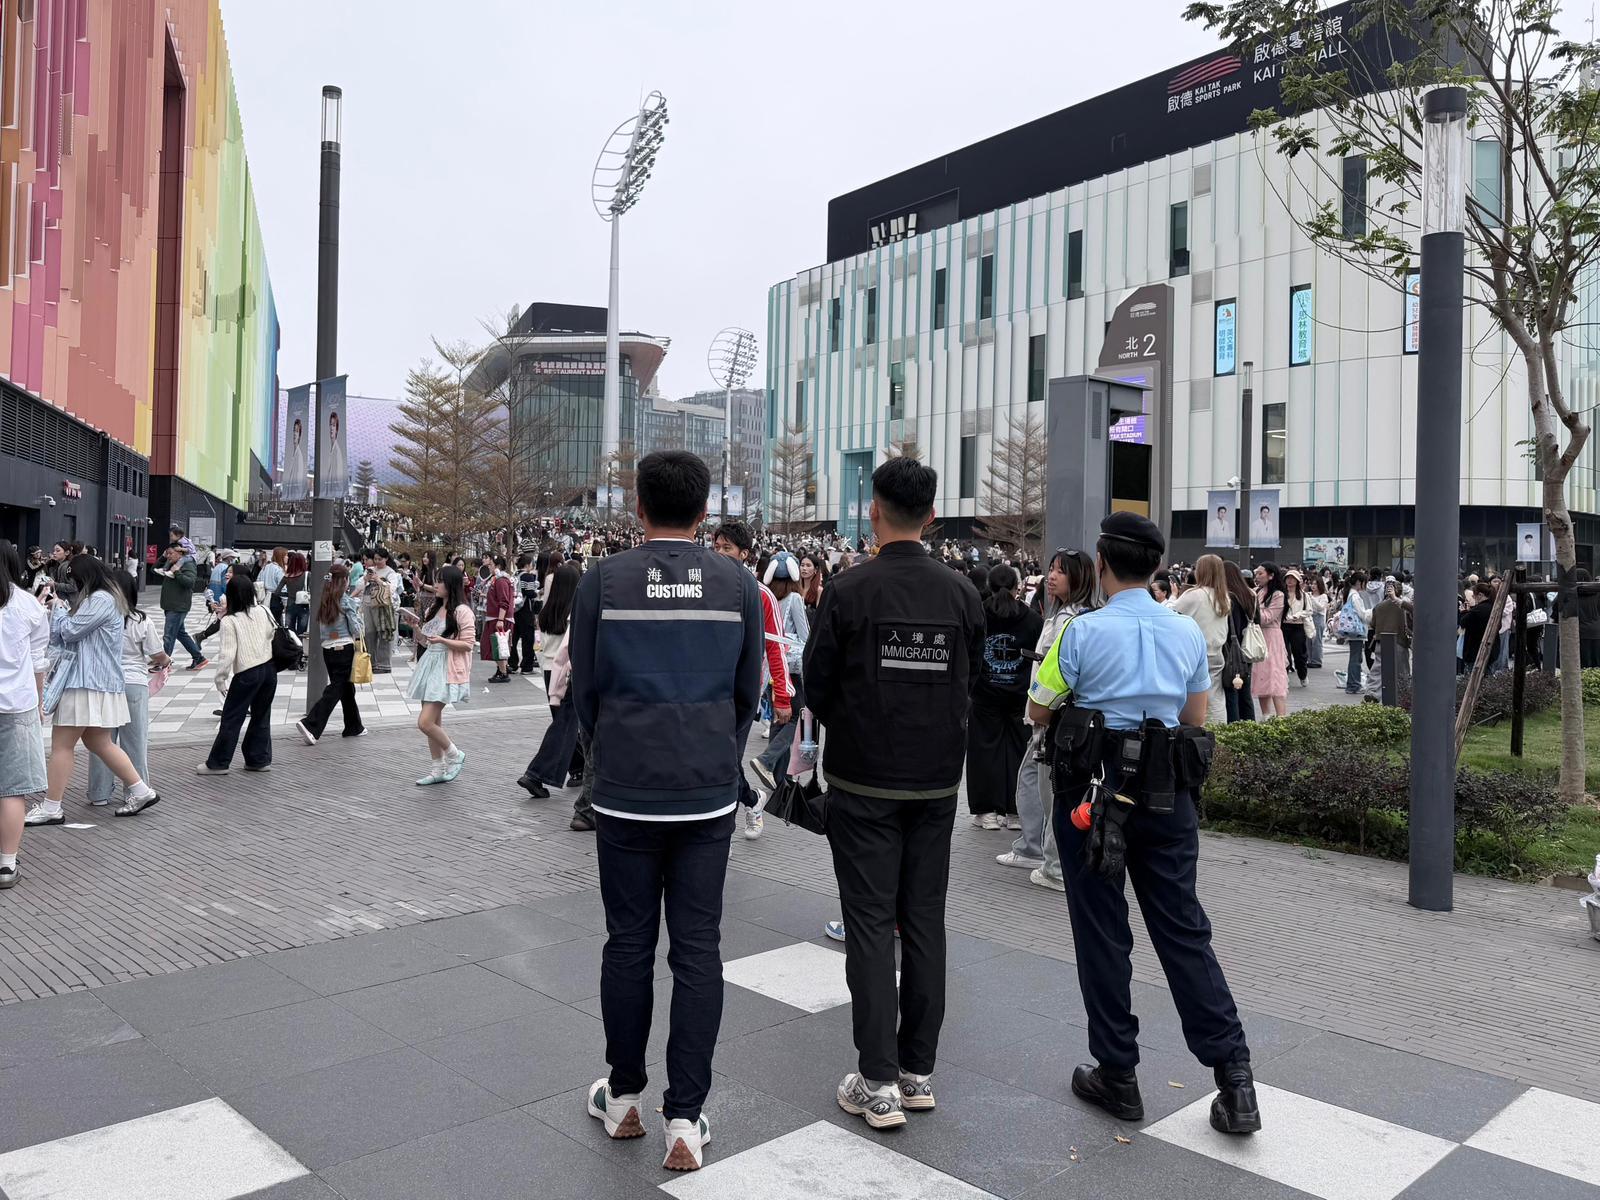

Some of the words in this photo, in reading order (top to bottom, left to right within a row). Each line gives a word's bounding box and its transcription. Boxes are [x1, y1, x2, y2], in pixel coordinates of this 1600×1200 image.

[1253, 64, 1276, 84] KAI
[1194, 84, 1207, 96] KAI
[1207, 80, 1221, 92] TAK
[1194, 88, 1221, 104] SPORTS
[1223, 80, 1242, 94] PARK
[1167, 90, 1193, 113] 啟德
[1125, 336, 1139, 350] 北
[1143, 333, 1156, 357] 2
[1118, 351, 1138, 360] NORTH
[647, 567, 702, 583] 海關
[646, 583, 703, 599] CUSTOMS
[888, 630, 946, 645] 入境處
[881, 644, 950, 661] IMMIGRATION
